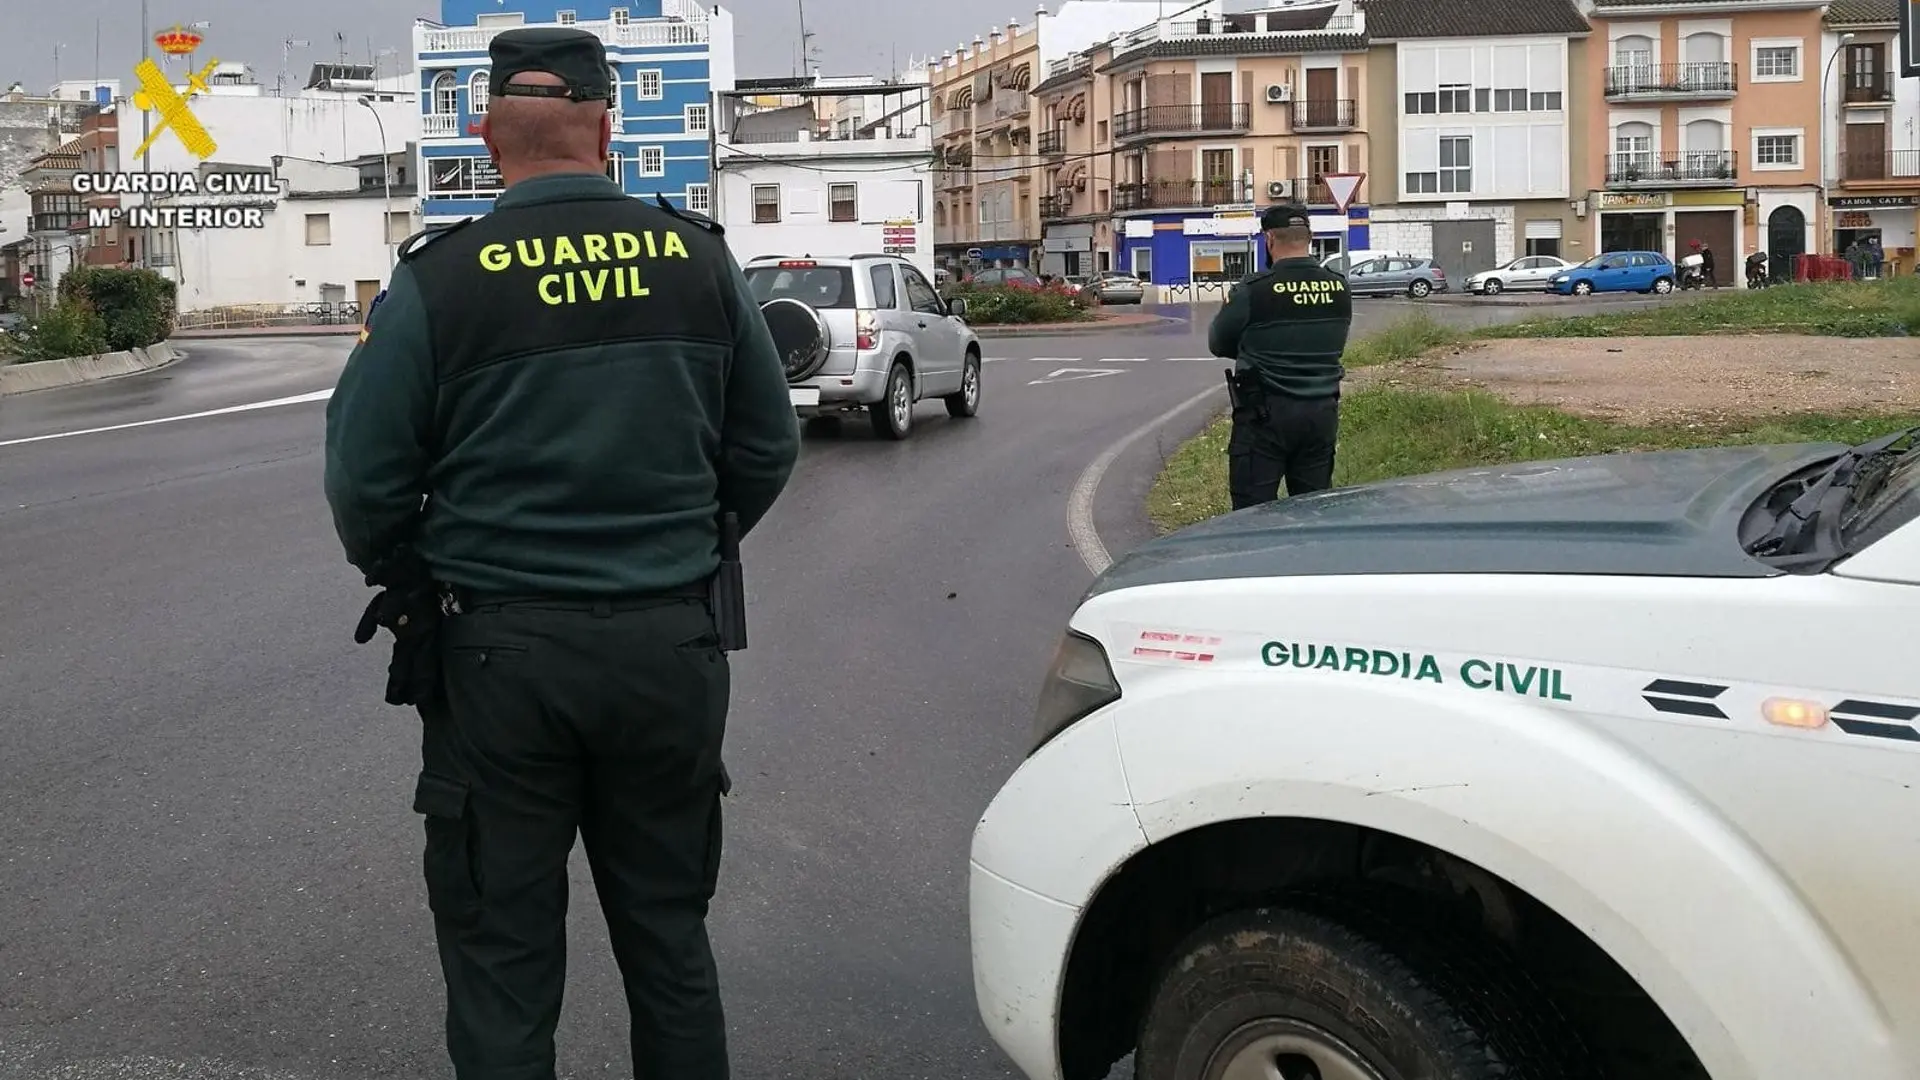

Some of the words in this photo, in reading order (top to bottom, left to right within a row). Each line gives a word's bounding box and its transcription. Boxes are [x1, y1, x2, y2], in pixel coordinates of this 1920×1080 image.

[479, 230, 690, 272] GUARDIA
[538, 266, 650, 305] CIVIL
[1273, 280, 1345, 293] GUARDIA
[1293, 292, 1334, 304] CIVIL
[1261, 641, 1443, 684] GUARDIA
[1460, 658, 1573, 701] CIVIL
